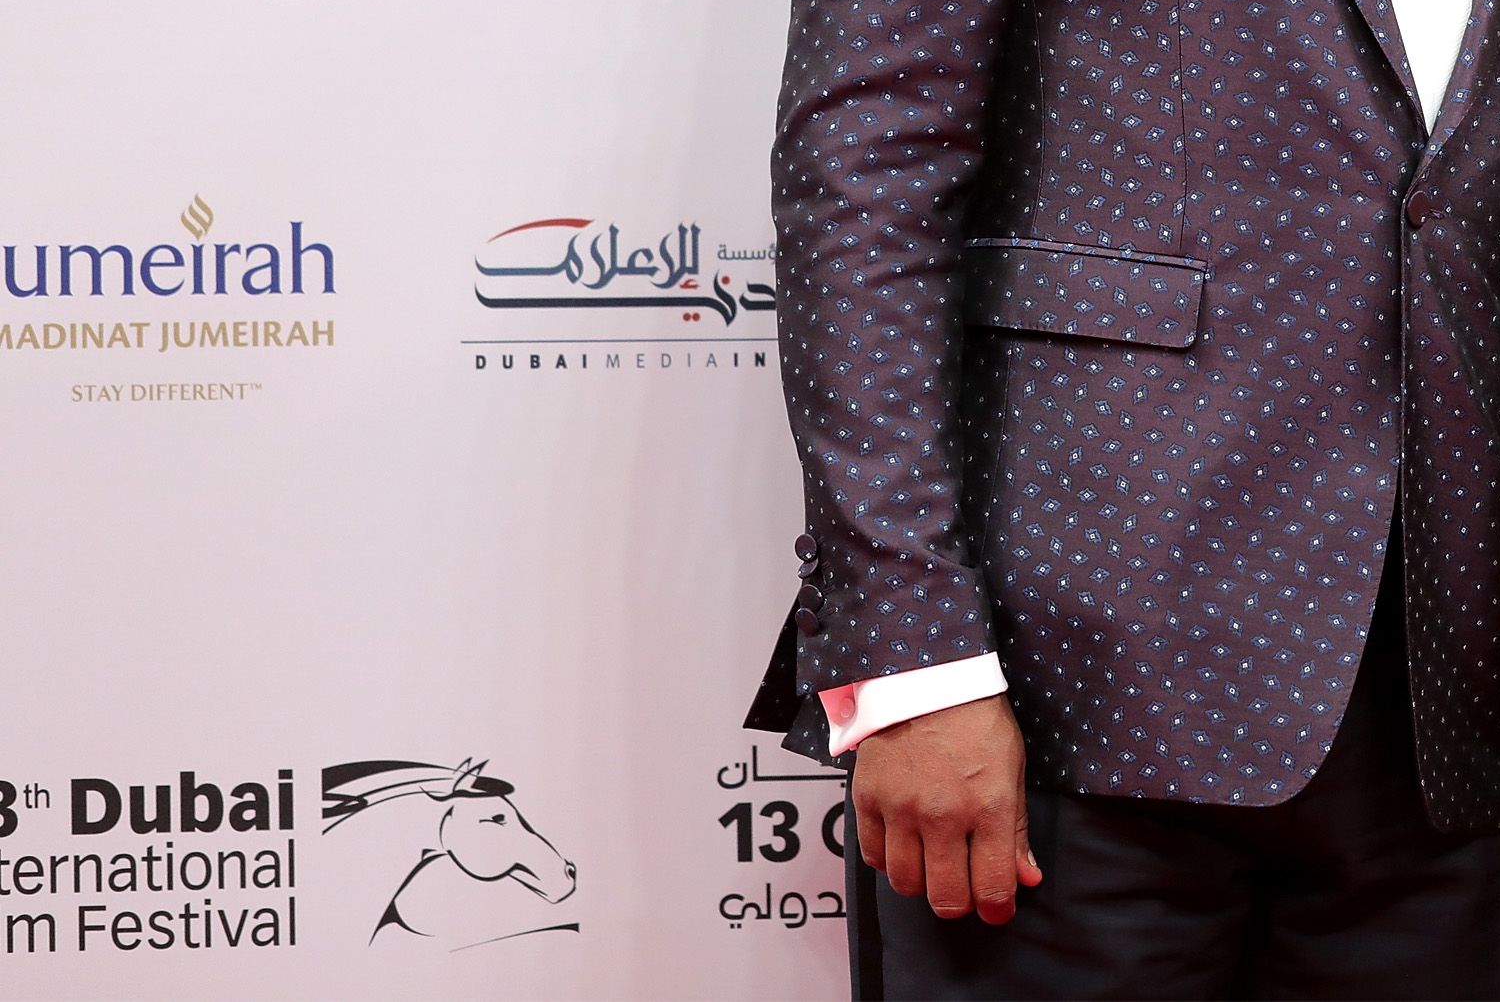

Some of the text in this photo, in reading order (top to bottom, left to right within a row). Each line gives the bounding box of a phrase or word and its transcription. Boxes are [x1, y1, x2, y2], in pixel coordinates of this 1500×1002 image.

[3, 221, 337, 298] umeirah
[159, 321, 333, 352] JUMEIRAH
[72, 385, 123, 402] STAY
[71, 769, 294, 836] Dubai
[719, 801, 800, 862] 13
[79, 897, 295, 951] Festival
